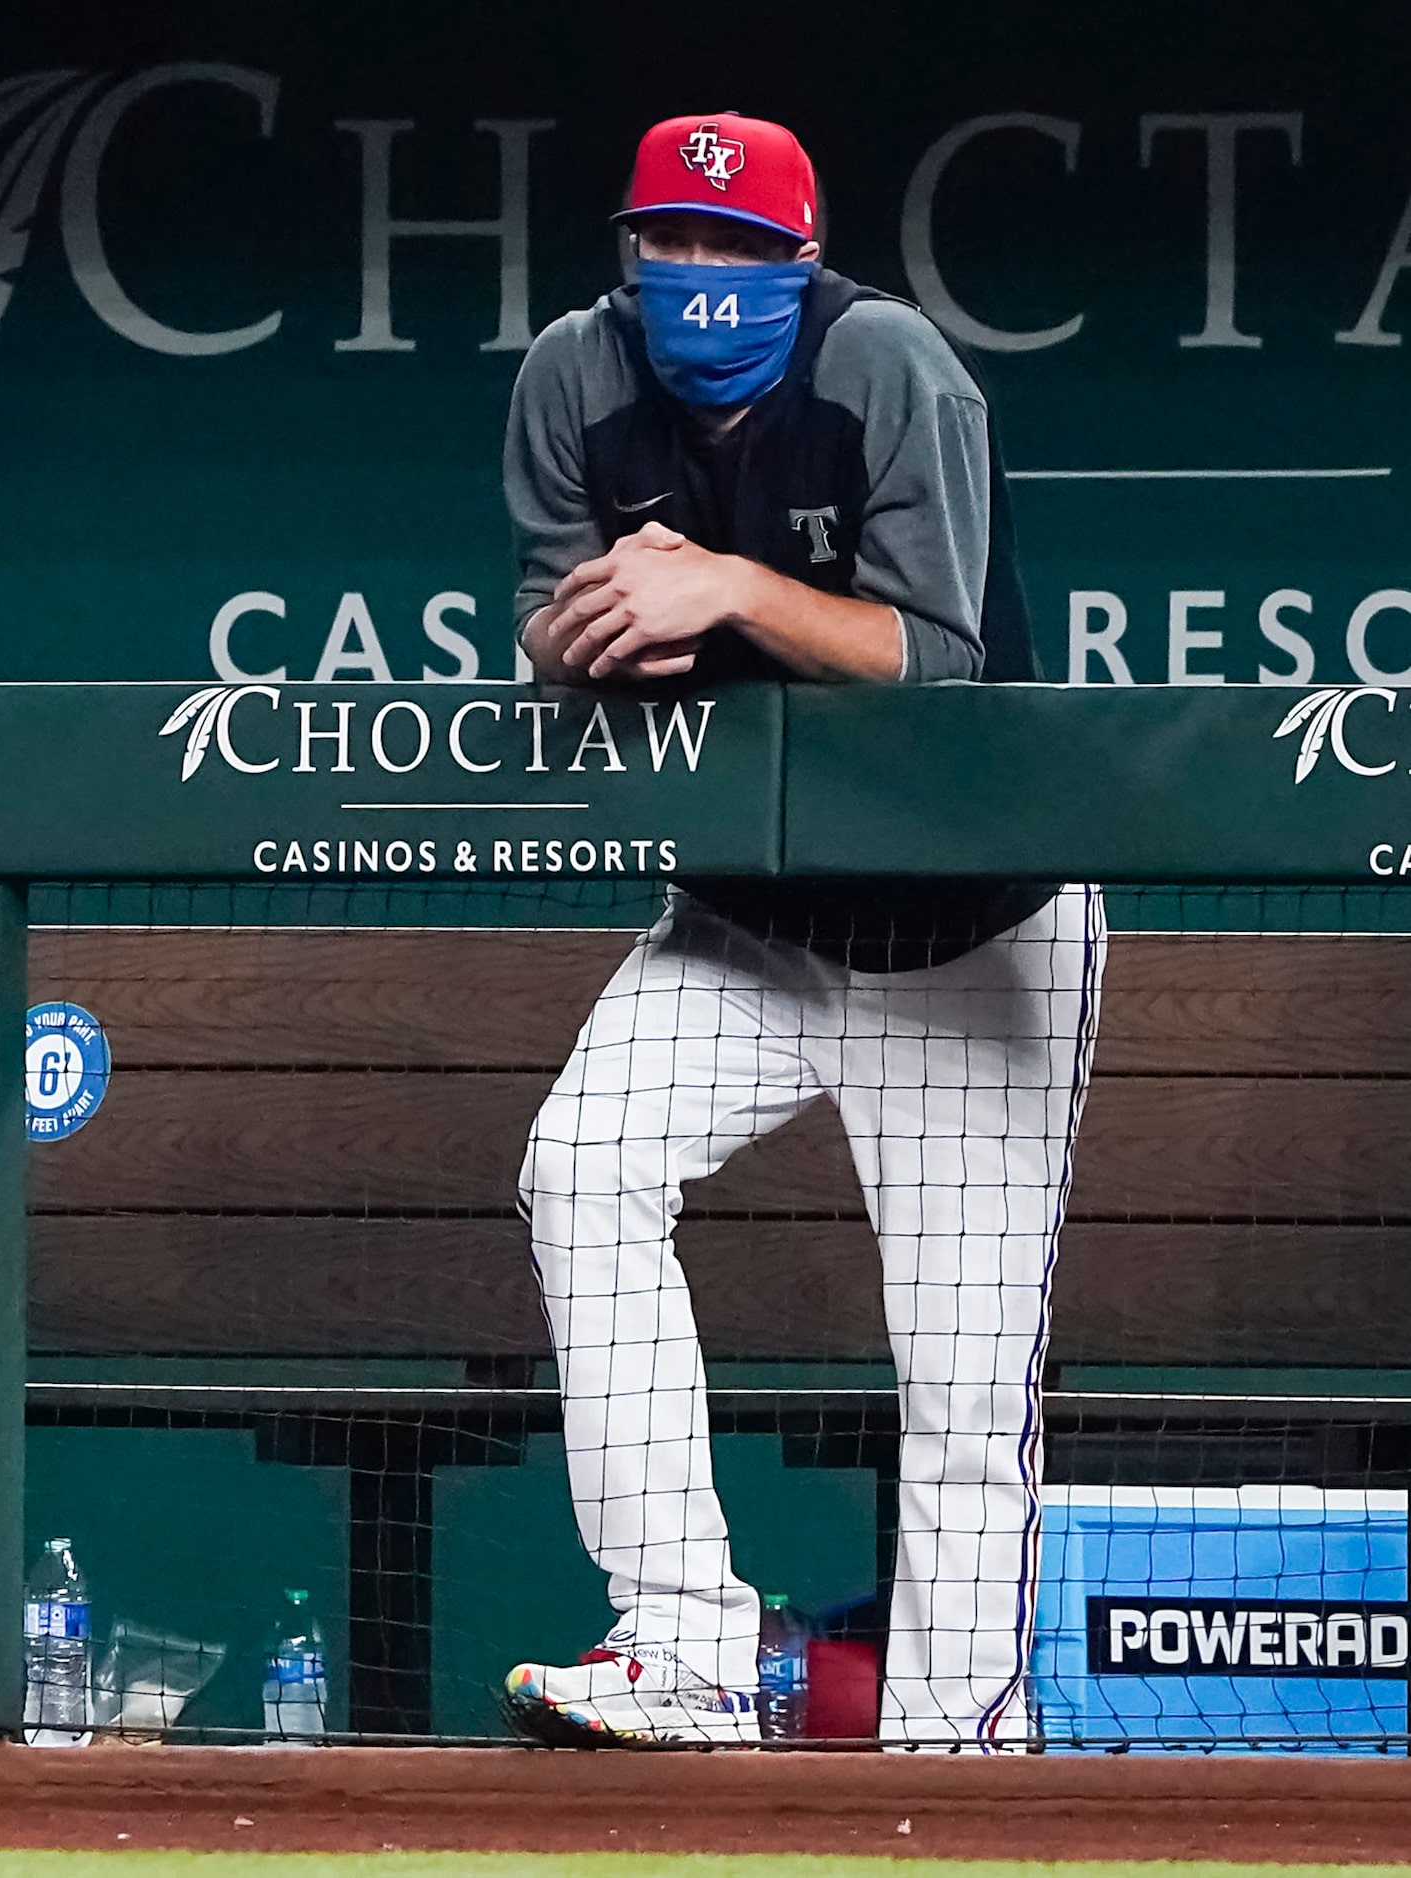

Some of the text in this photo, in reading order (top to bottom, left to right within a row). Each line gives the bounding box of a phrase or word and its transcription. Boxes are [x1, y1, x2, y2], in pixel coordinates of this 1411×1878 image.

[689, 132, 735, 180] TX
[682, 292, 740, 329] 44
[788, 505, 839, 564] T
[217, 685, 717, 774] CHOCTAW
[1330, 687, 1411, 776] C
[253, 839, 677, 873] CASINOS & RESORTS
[34, 1011, 66, 1031] YOUR
[31, 1116, 58, 1133] FEET
[1109, 1608, 1409, 1668] POWERAD
